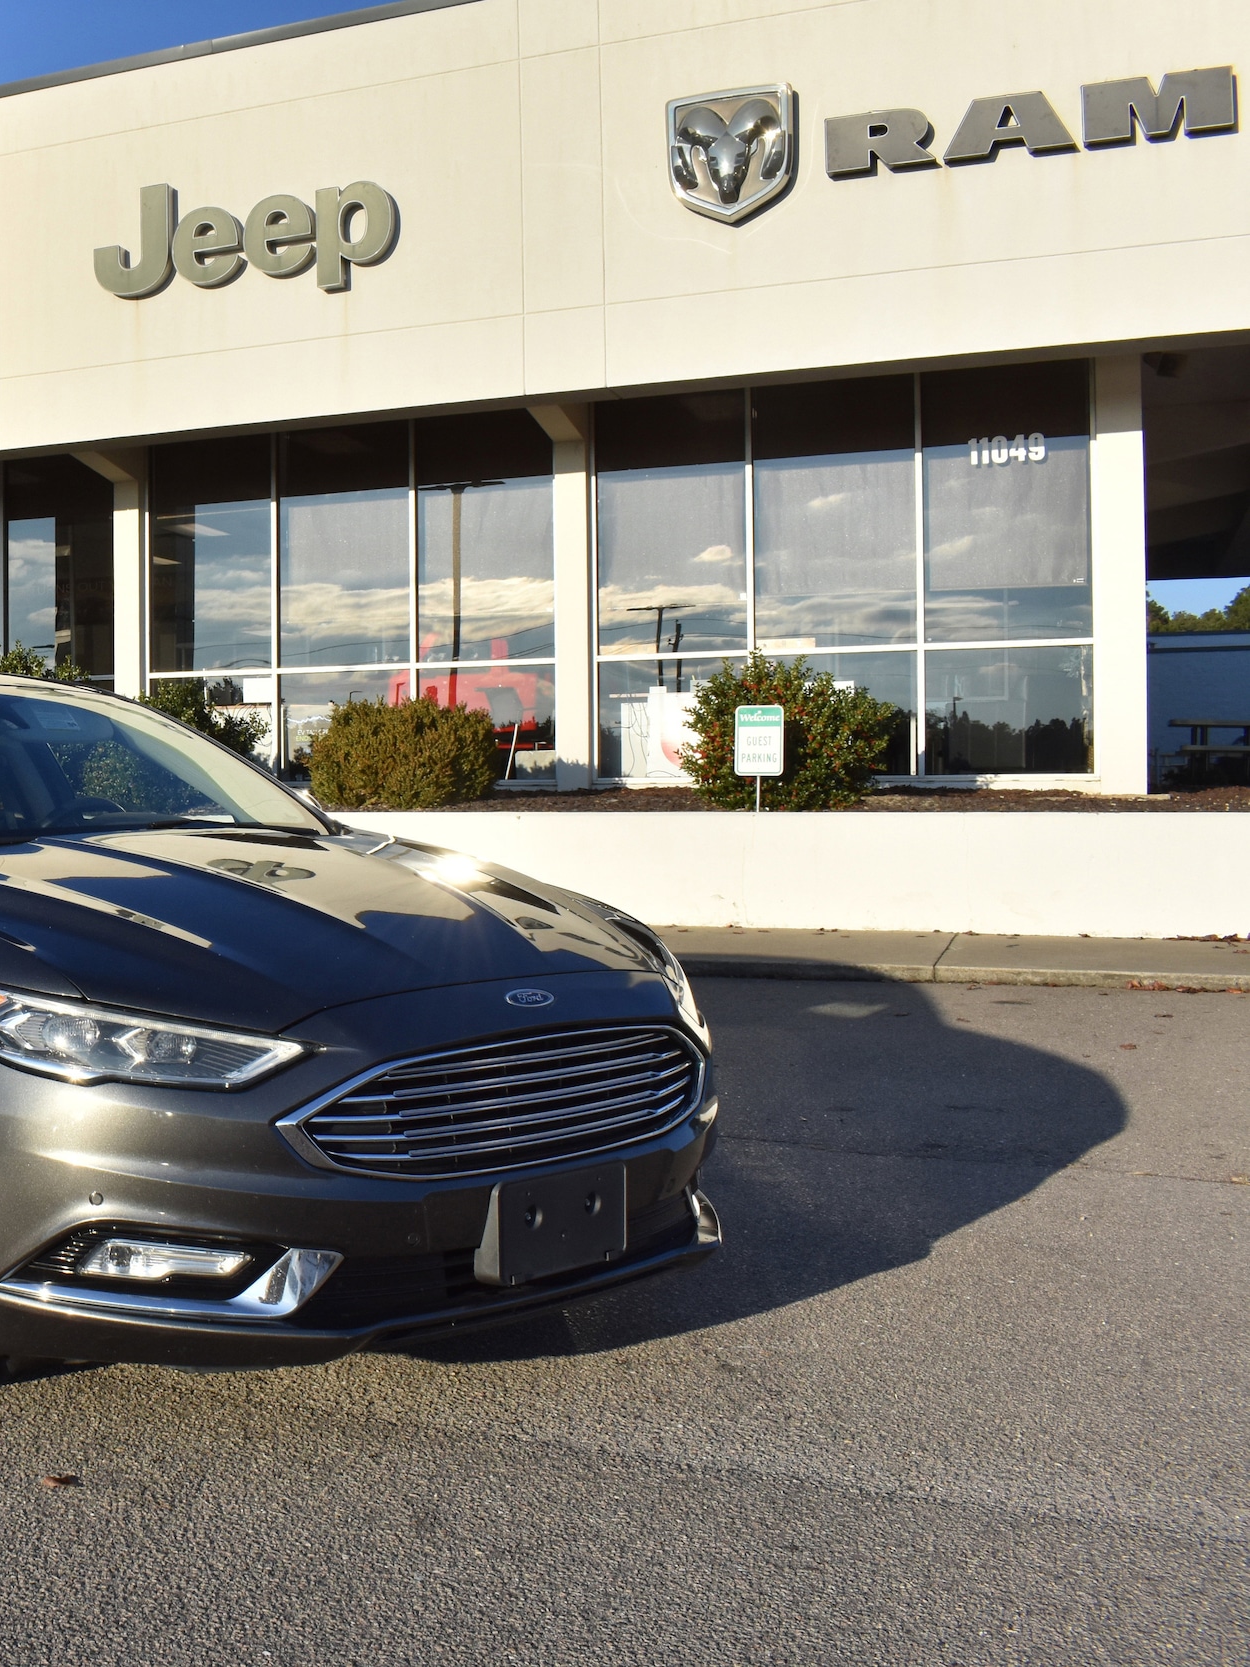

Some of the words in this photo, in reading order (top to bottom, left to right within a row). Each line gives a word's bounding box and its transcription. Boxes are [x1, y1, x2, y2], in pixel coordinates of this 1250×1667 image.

[824, 65, 1239, 181] RAM
[94, 180, 401, 299] Jeep
[968, 432, 1047, 466] 11049
[740, 710, 781, 722] Welcome
[746, 735, 772, 746] GUEST
[741, 752, 777, 763] PARKING
[516, 992, 544, 1003] Ford
